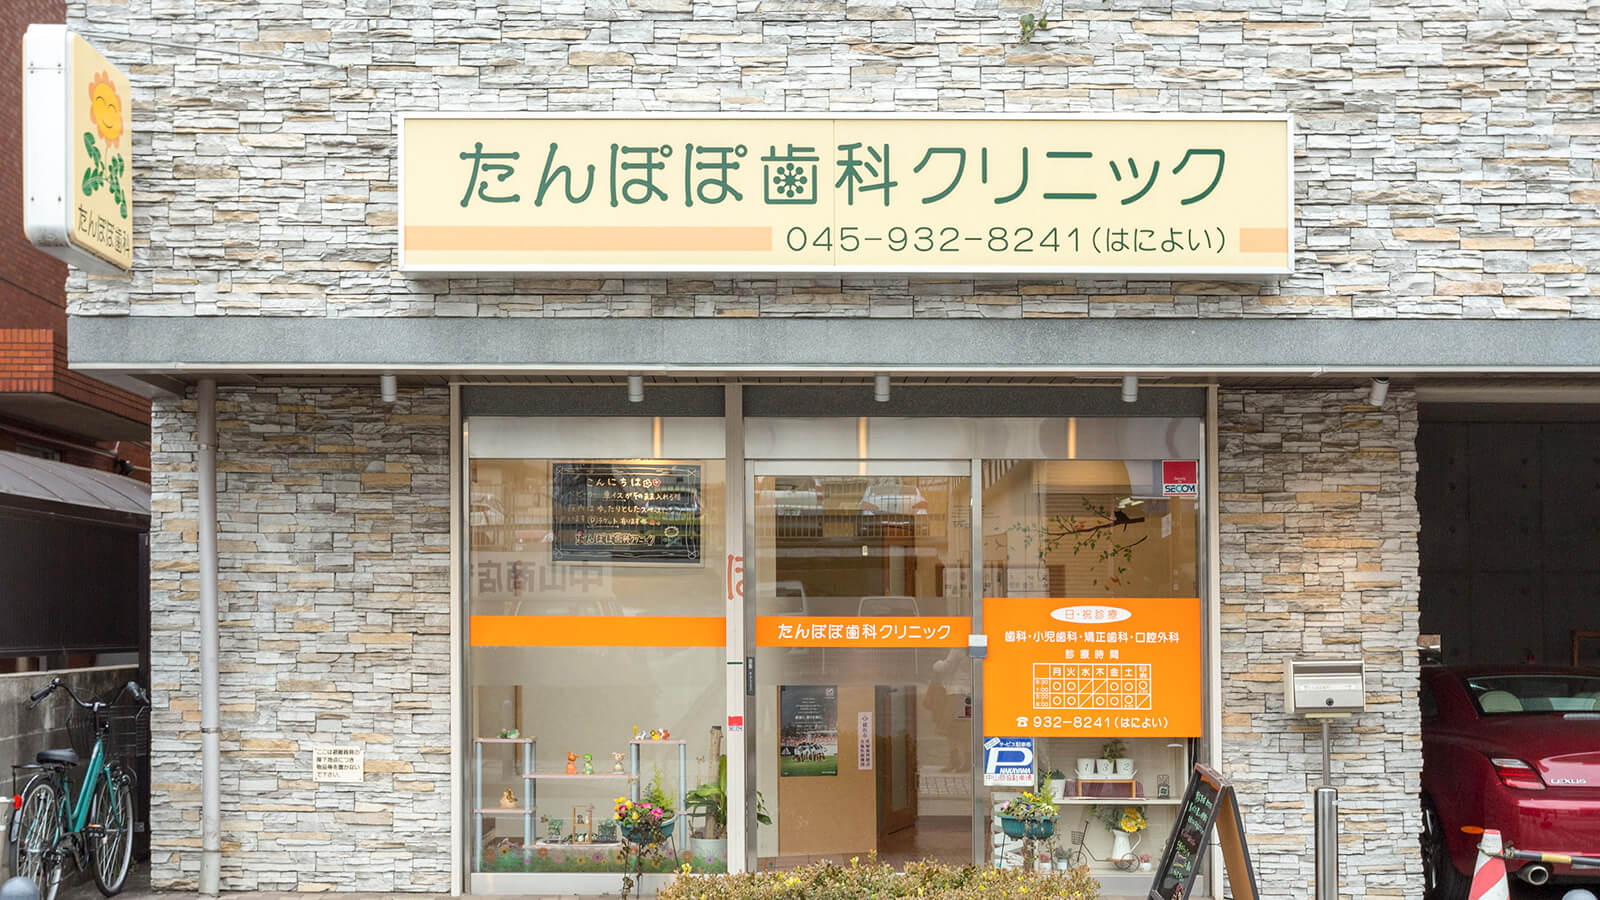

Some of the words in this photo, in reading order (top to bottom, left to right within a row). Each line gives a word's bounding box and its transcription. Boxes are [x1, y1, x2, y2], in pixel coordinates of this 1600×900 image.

[459, 142, 1226, 208] たんぽぽ歯科クリニック
[786, 226, 1226, 255] 045-932-8241(はによい)
[587, 477, 643, 488] こんにちは
[1165, 484, 1196, 493] SECOM
[778, 623, 951, 641] たんぽぽ歯科クリニック
[1004, 631, 1180, 644] 歯科・小児歯科・矯正歯科・口腔外科
[1052, 667, 1062, 677] 月
[1066, 667, 1076, 677] 火
[1080, 667, 1090, 677] 水
[1095, 667, 1105, 677] 木
[1109, 667, 1119, 677] 金
[1123, 667, 1133, 677] 土
[1033, 715, 1168, 729] 932-8241(はによい)
[986, 747, 1033, 774] P
